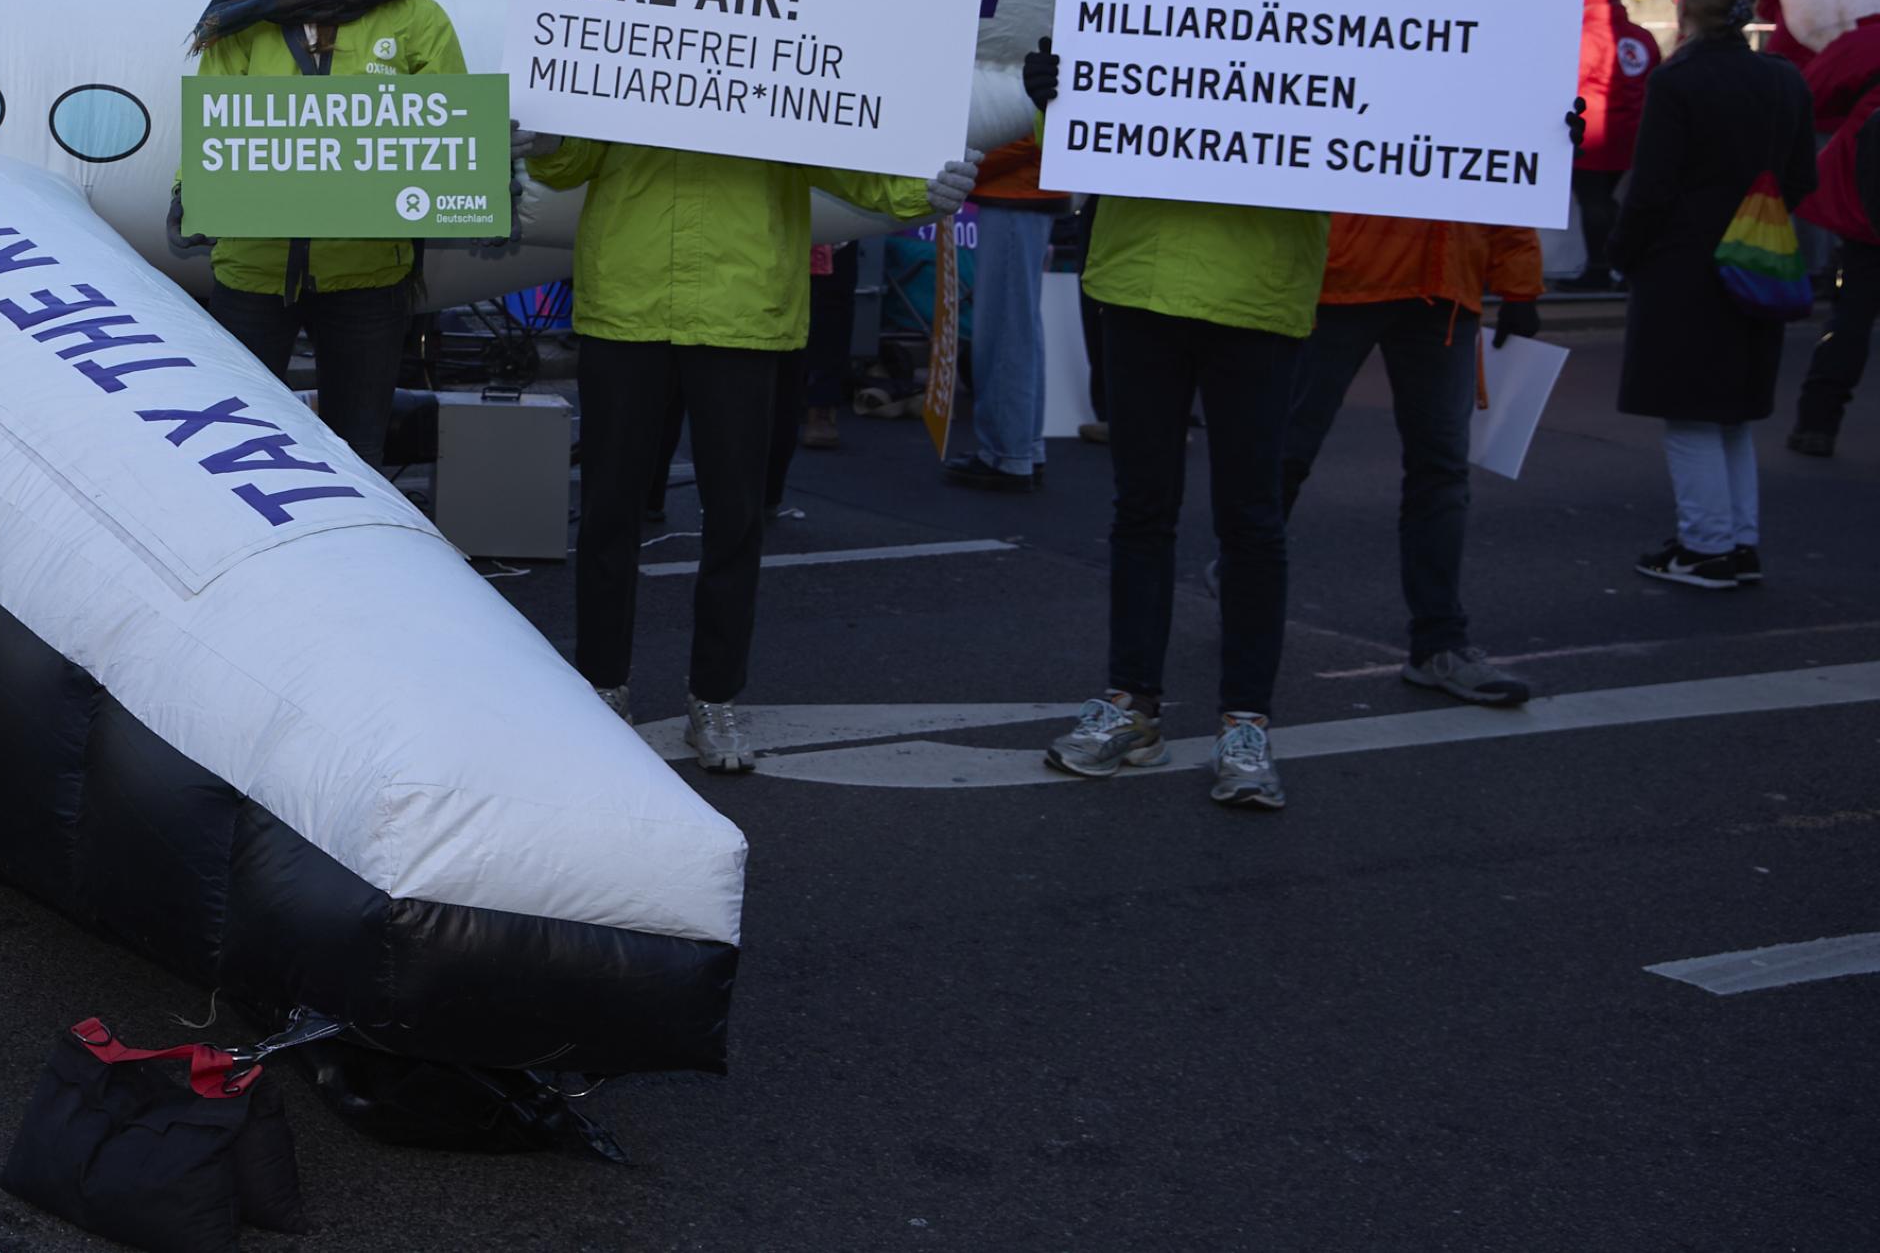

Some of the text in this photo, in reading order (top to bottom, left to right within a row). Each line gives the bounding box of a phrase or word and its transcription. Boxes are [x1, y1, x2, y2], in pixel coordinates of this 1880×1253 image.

[533, 12, 844, 79] STEUERFREI FÜR
[1077, 1, 1479, 53] MILLIARDÄRSMACHT
[202, 84, 468, 127] MILLIARDÄRS-
[1072, 60, 1370, 115] BESCHRÄNKEN,
[202, 137, 477, 172] STEUER JETZT!
[1066, 118, 1540, 186] DEMOKRATIE SCHÜTZEN
[436, 195, 487, 210] OXFAM
[436, 213, 494, 224] Deutschland
[134, 397, 365, 527] TAX
